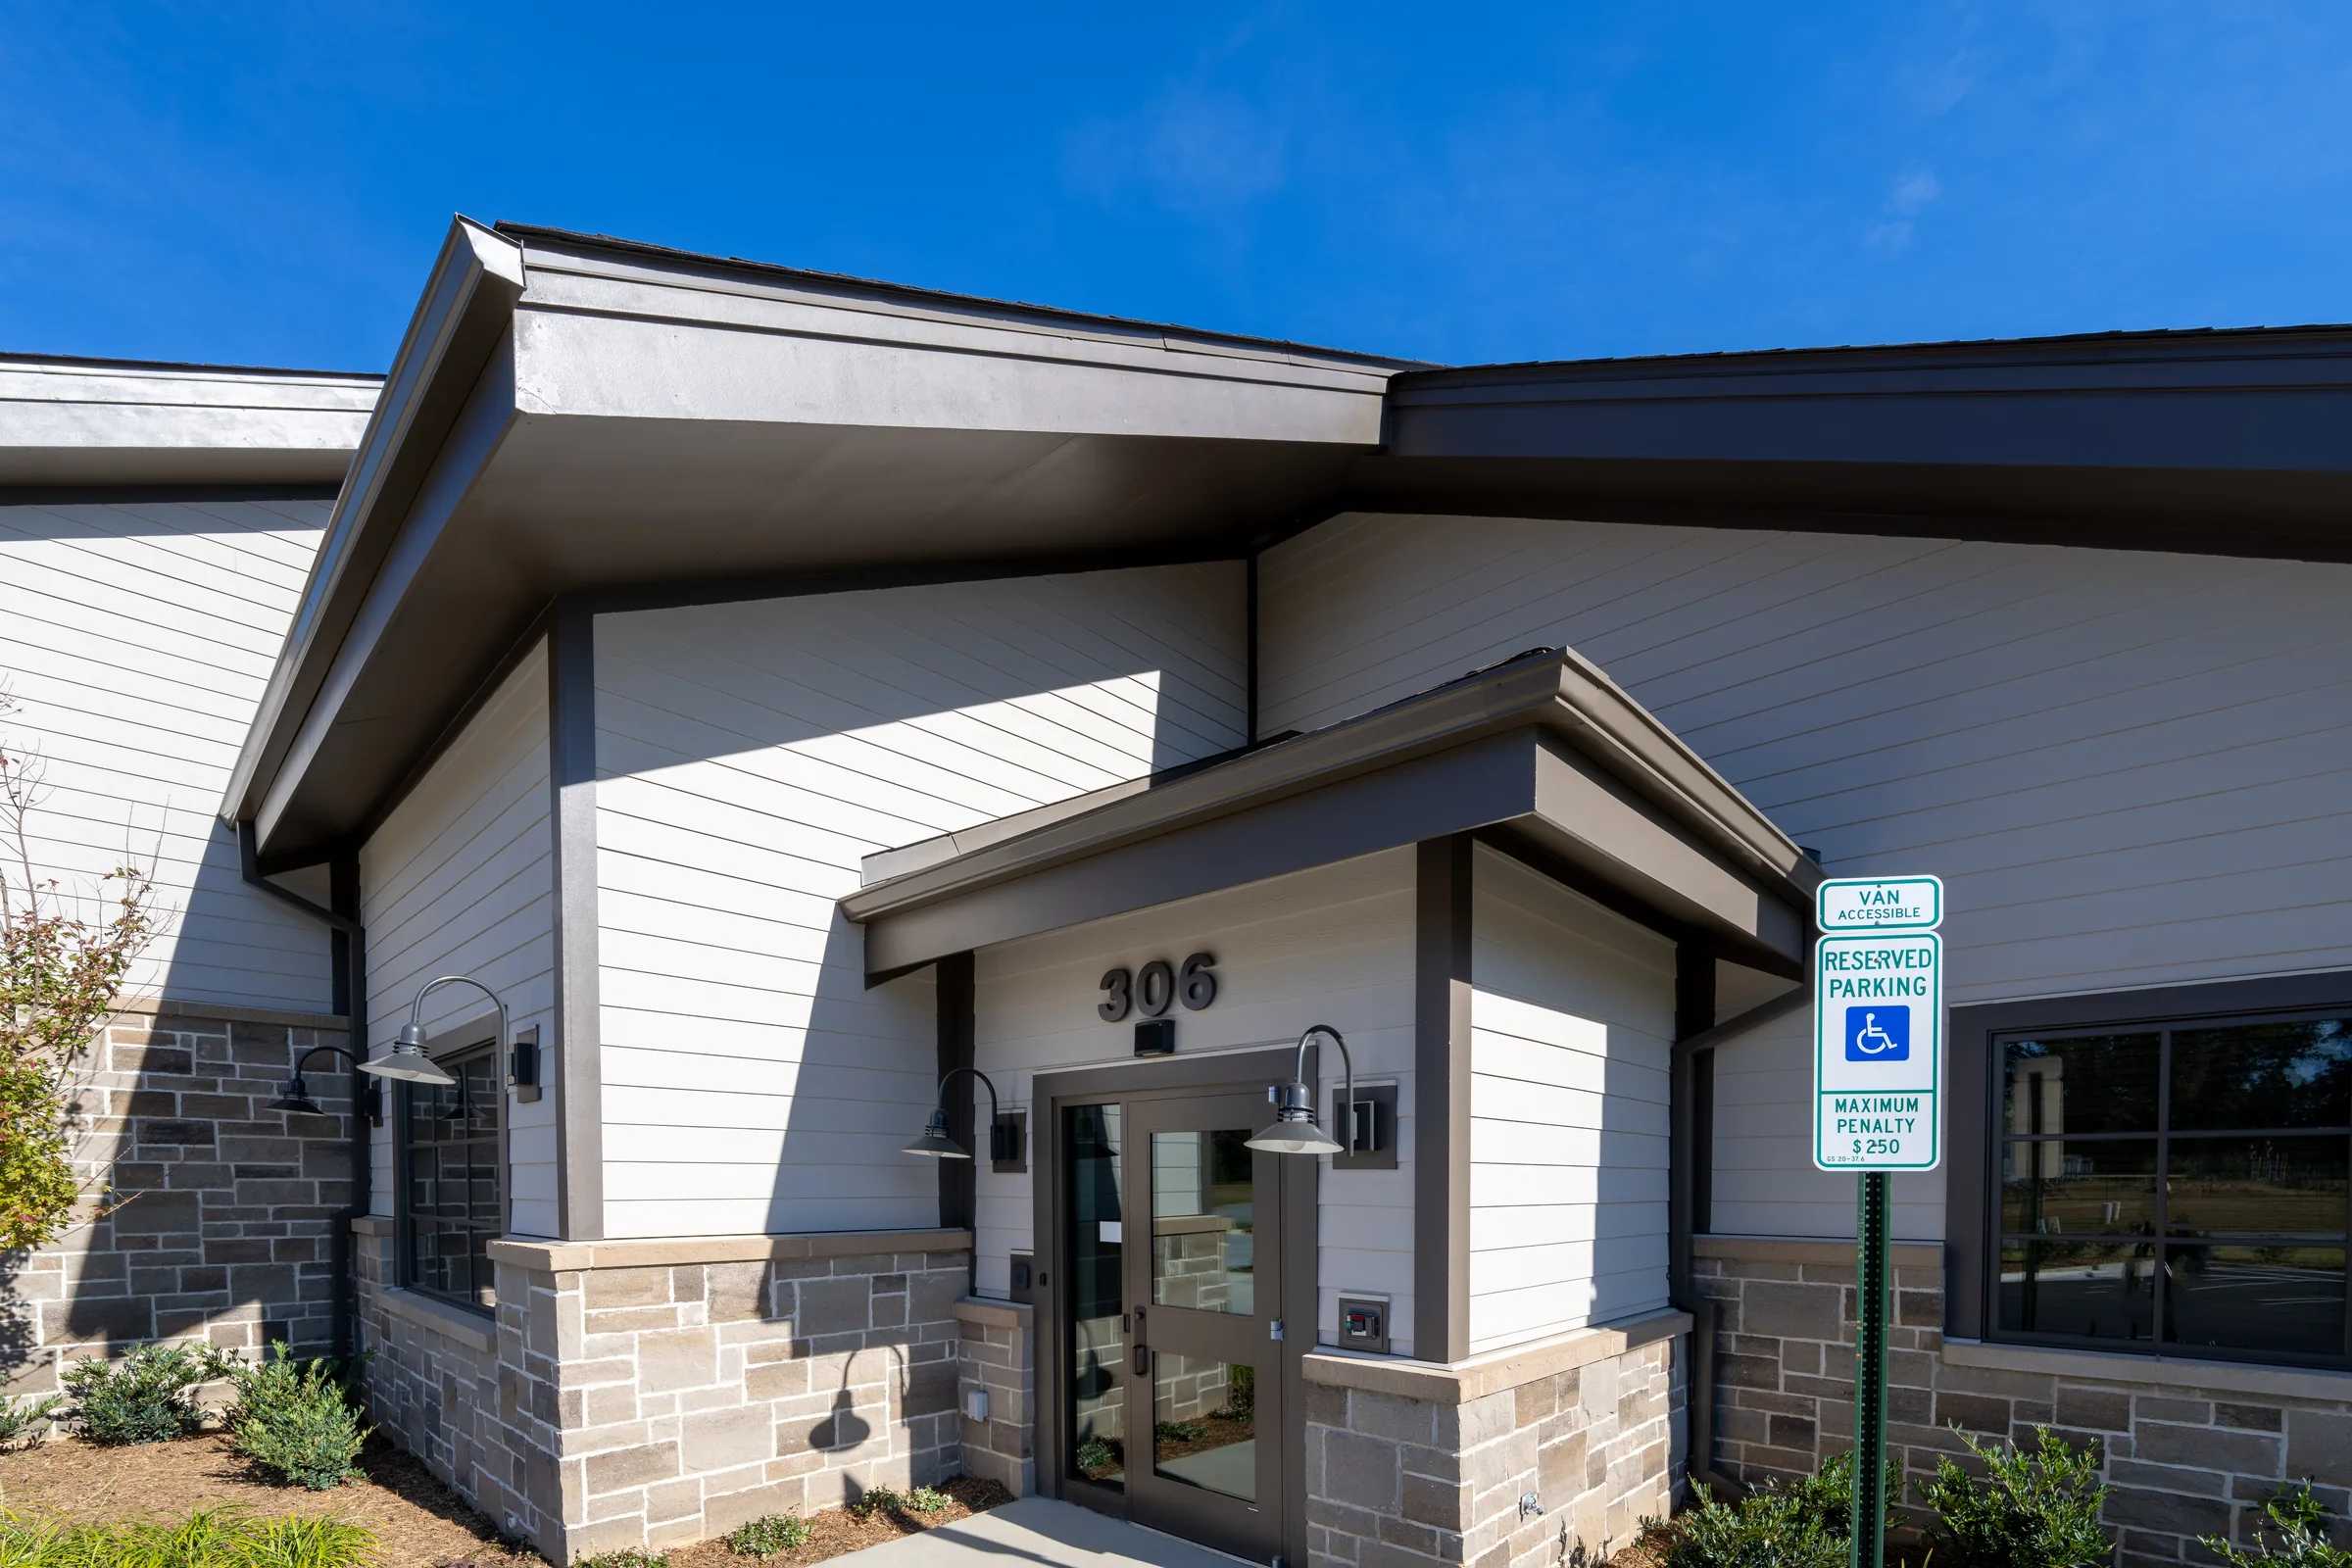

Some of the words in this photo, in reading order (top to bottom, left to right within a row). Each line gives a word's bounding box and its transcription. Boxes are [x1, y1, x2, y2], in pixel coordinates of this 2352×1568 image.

[1859, 890, 1899, 906] VAN
[1838, 907, 1921, 920] ACCESSIBLE
[1825, 949, 1933, 971] RESERVED
[1098, 953, 1216, 1022] 306
[1830, 976, 1927, 999] PARKING
[1835, 1098, 1919, 1113] MAXIMUM
[1837, 1118, 1915, 1134] PENALTY
